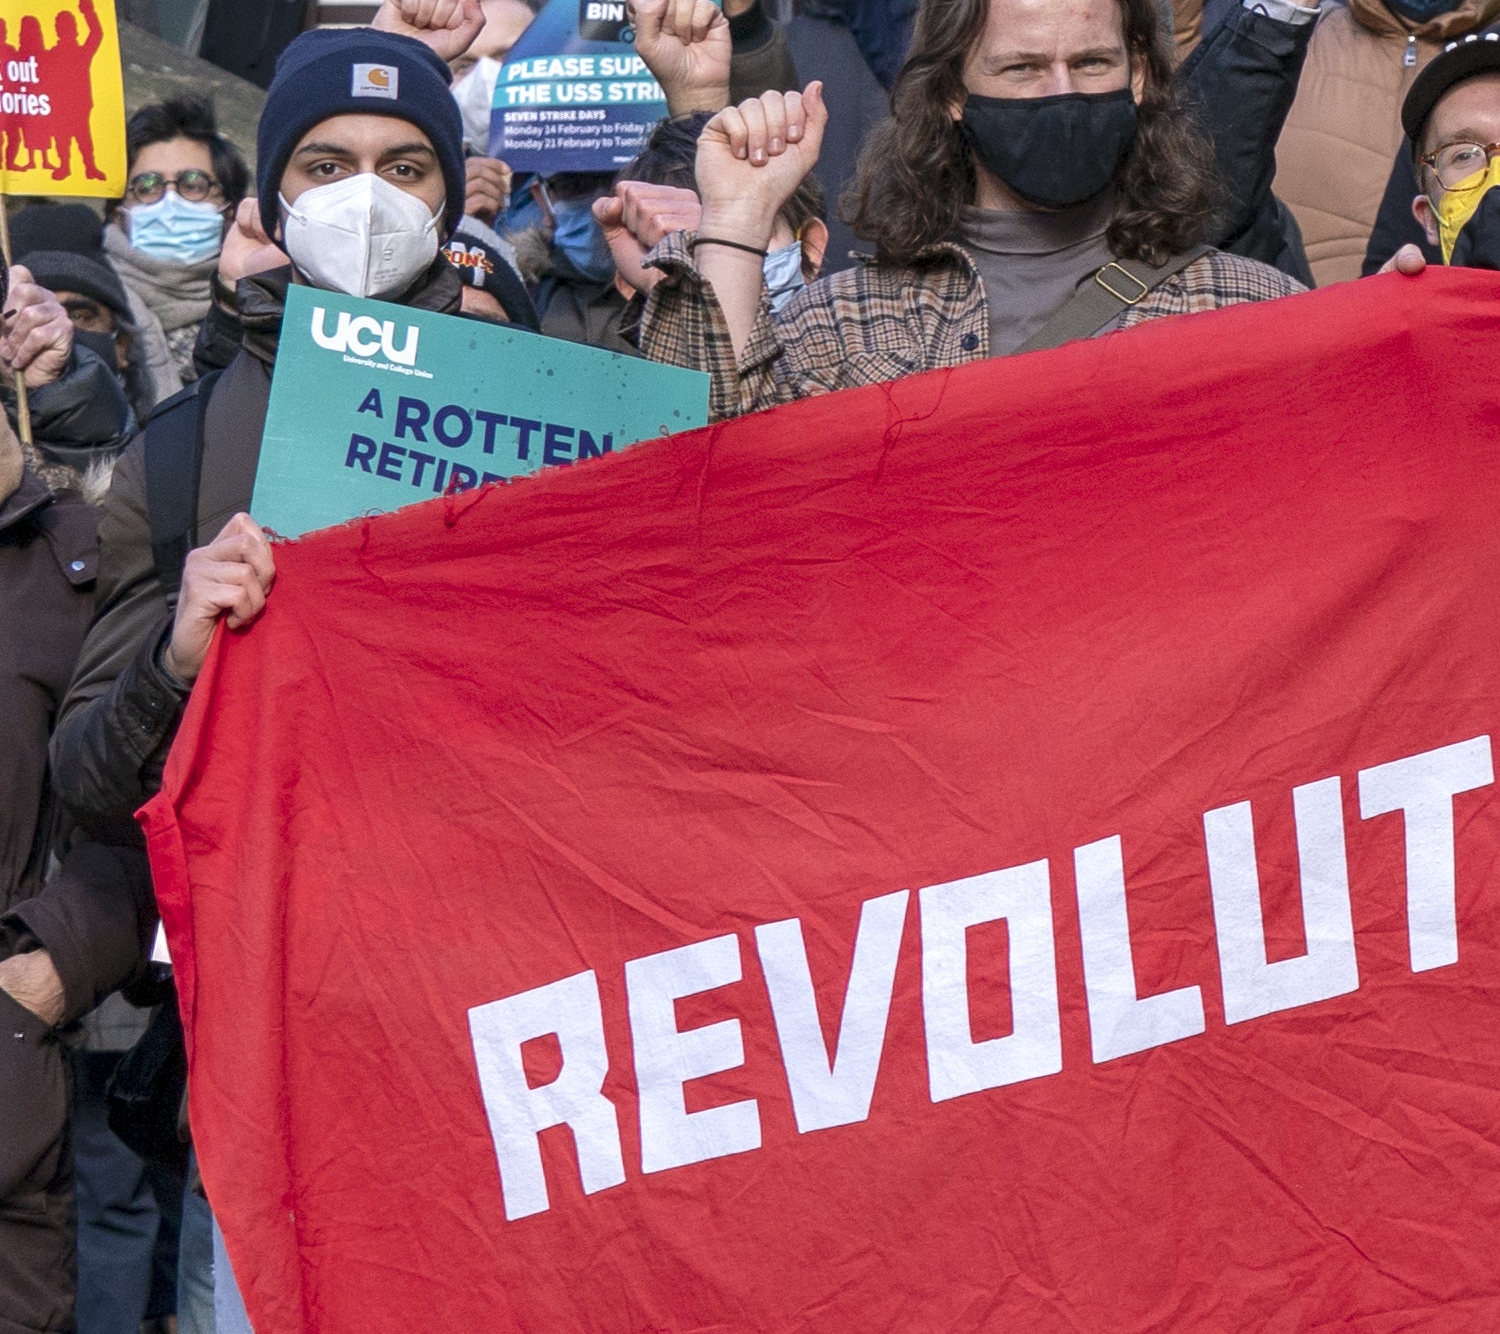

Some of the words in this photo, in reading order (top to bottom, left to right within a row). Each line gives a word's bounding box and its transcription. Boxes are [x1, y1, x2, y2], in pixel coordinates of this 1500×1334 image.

[586, 3, 624, 21] BIN
[9, 56, 39, 84] out
[507, 56, 595, 81] PLEASE
[506, 85, 551, 104] THE
[558, 82, 604, 101] USS
[311, 306, 419, 366] UCU
[357, 388, 383, 418] A
[394, 395, 613, 466] ROTTEN
